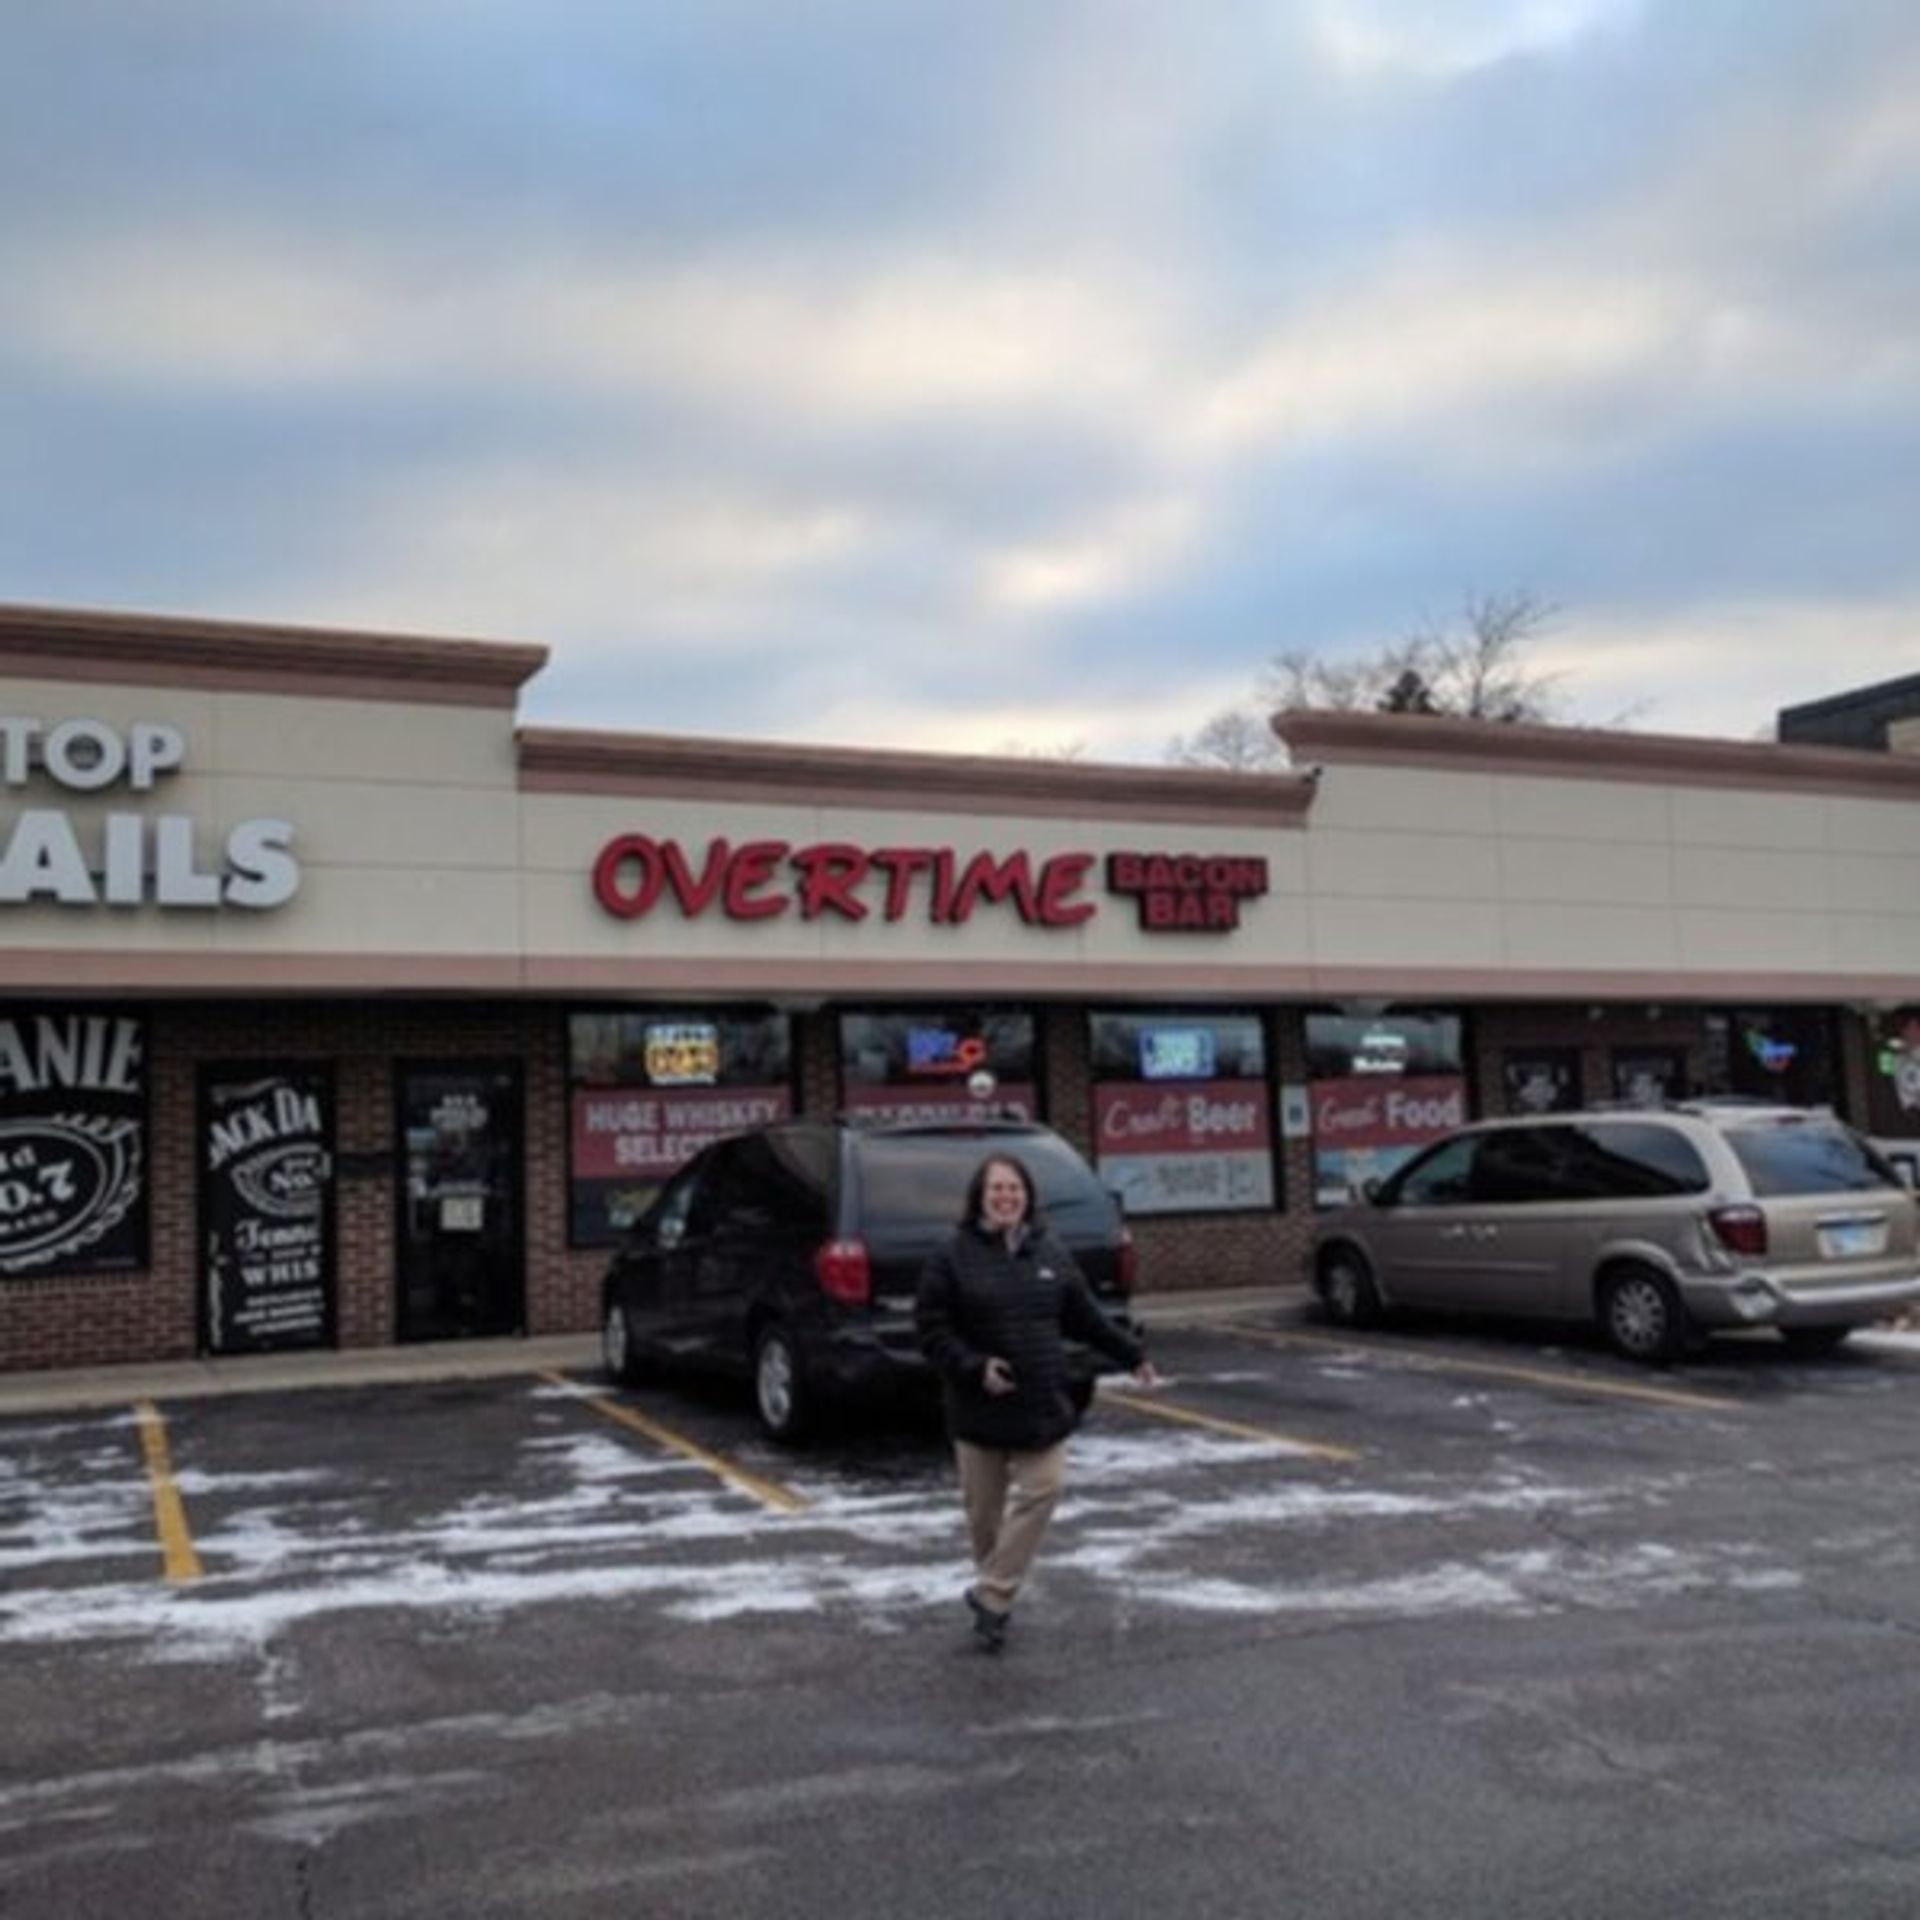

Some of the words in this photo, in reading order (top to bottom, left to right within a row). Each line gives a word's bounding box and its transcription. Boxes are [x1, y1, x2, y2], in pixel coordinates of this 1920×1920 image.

[0, 716, 185, 790] TOP
[0, 809, 300, 907] AILS
[1109, 853, 1266, 894] BACON
[592, 833, 1097, 927] OVERTIME
[1145, 891, 1235, 927] BAR
[586, 1100, 659, 1131] HUGE
[664, 1099, 778, 1130] WHISKEY
[1188, 1096, 1256, 1134] Beer
[1386, 1090, 1460, 1130] Food
